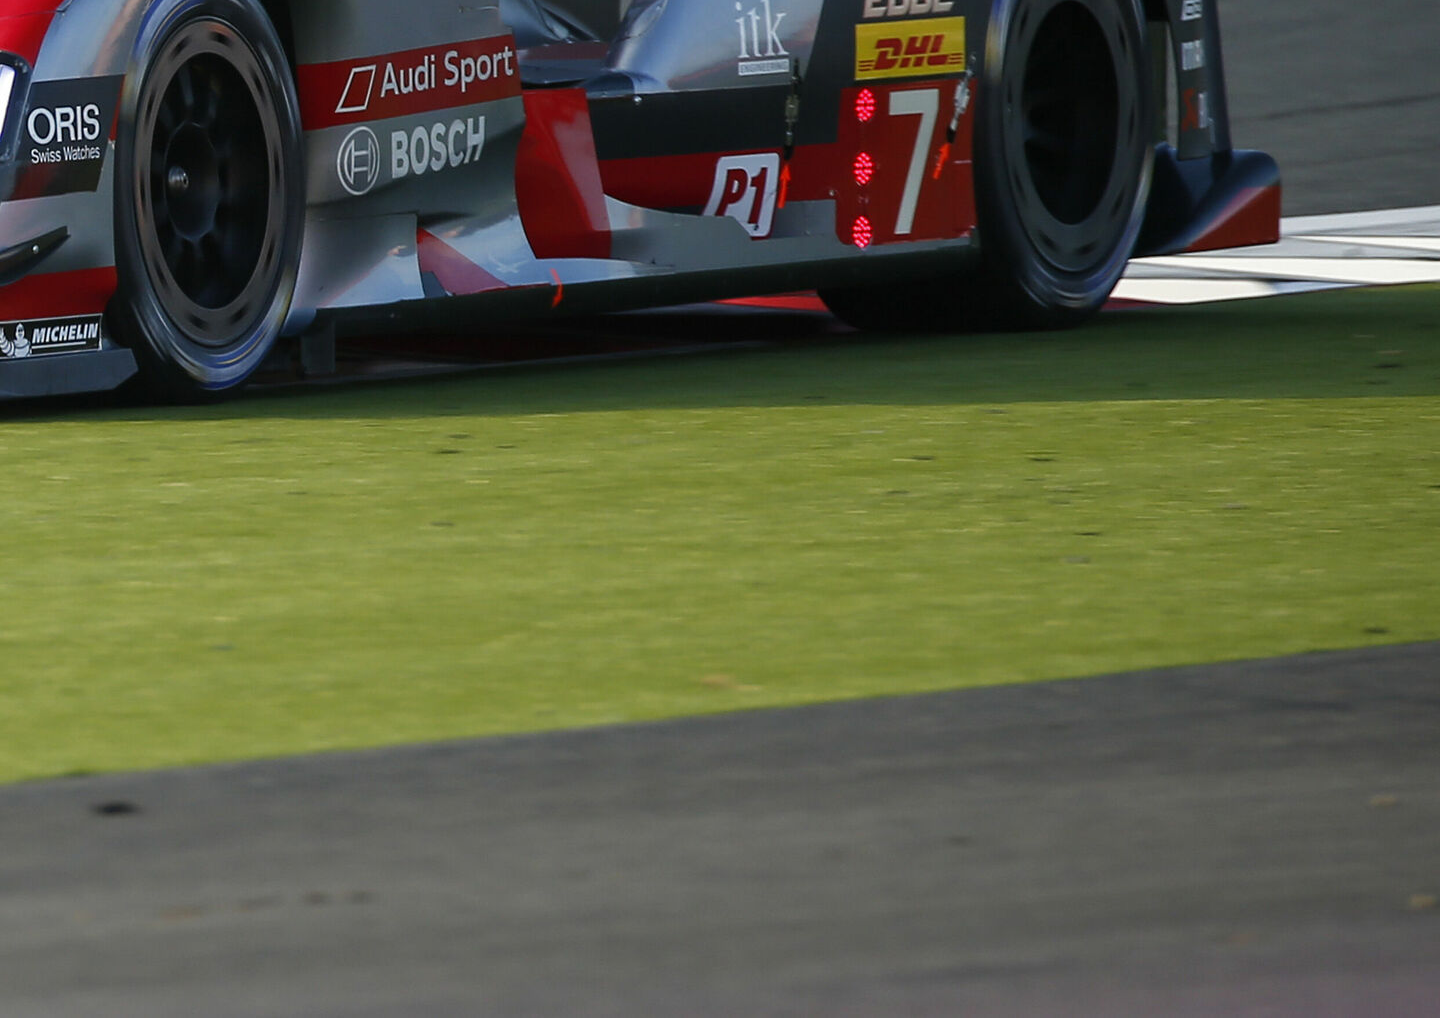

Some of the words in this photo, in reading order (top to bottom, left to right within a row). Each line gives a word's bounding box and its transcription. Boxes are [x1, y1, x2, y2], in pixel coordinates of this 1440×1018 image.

[380, 56, 437, 98] Audi
[444, 45, 514, 92] Sport
[873, 34, 950, 71] DHL
[27, 103, 100, 145] ORIS
[390, 115, 486, 179] BOSCH
[31, 148, 61, 164] Swiss
[64, 145, 100, 161] Watches
[889, 89, 940, 235] 7
[714, 166, 769, 224] P1
[32, 323, 98, 343] MICHELIN
